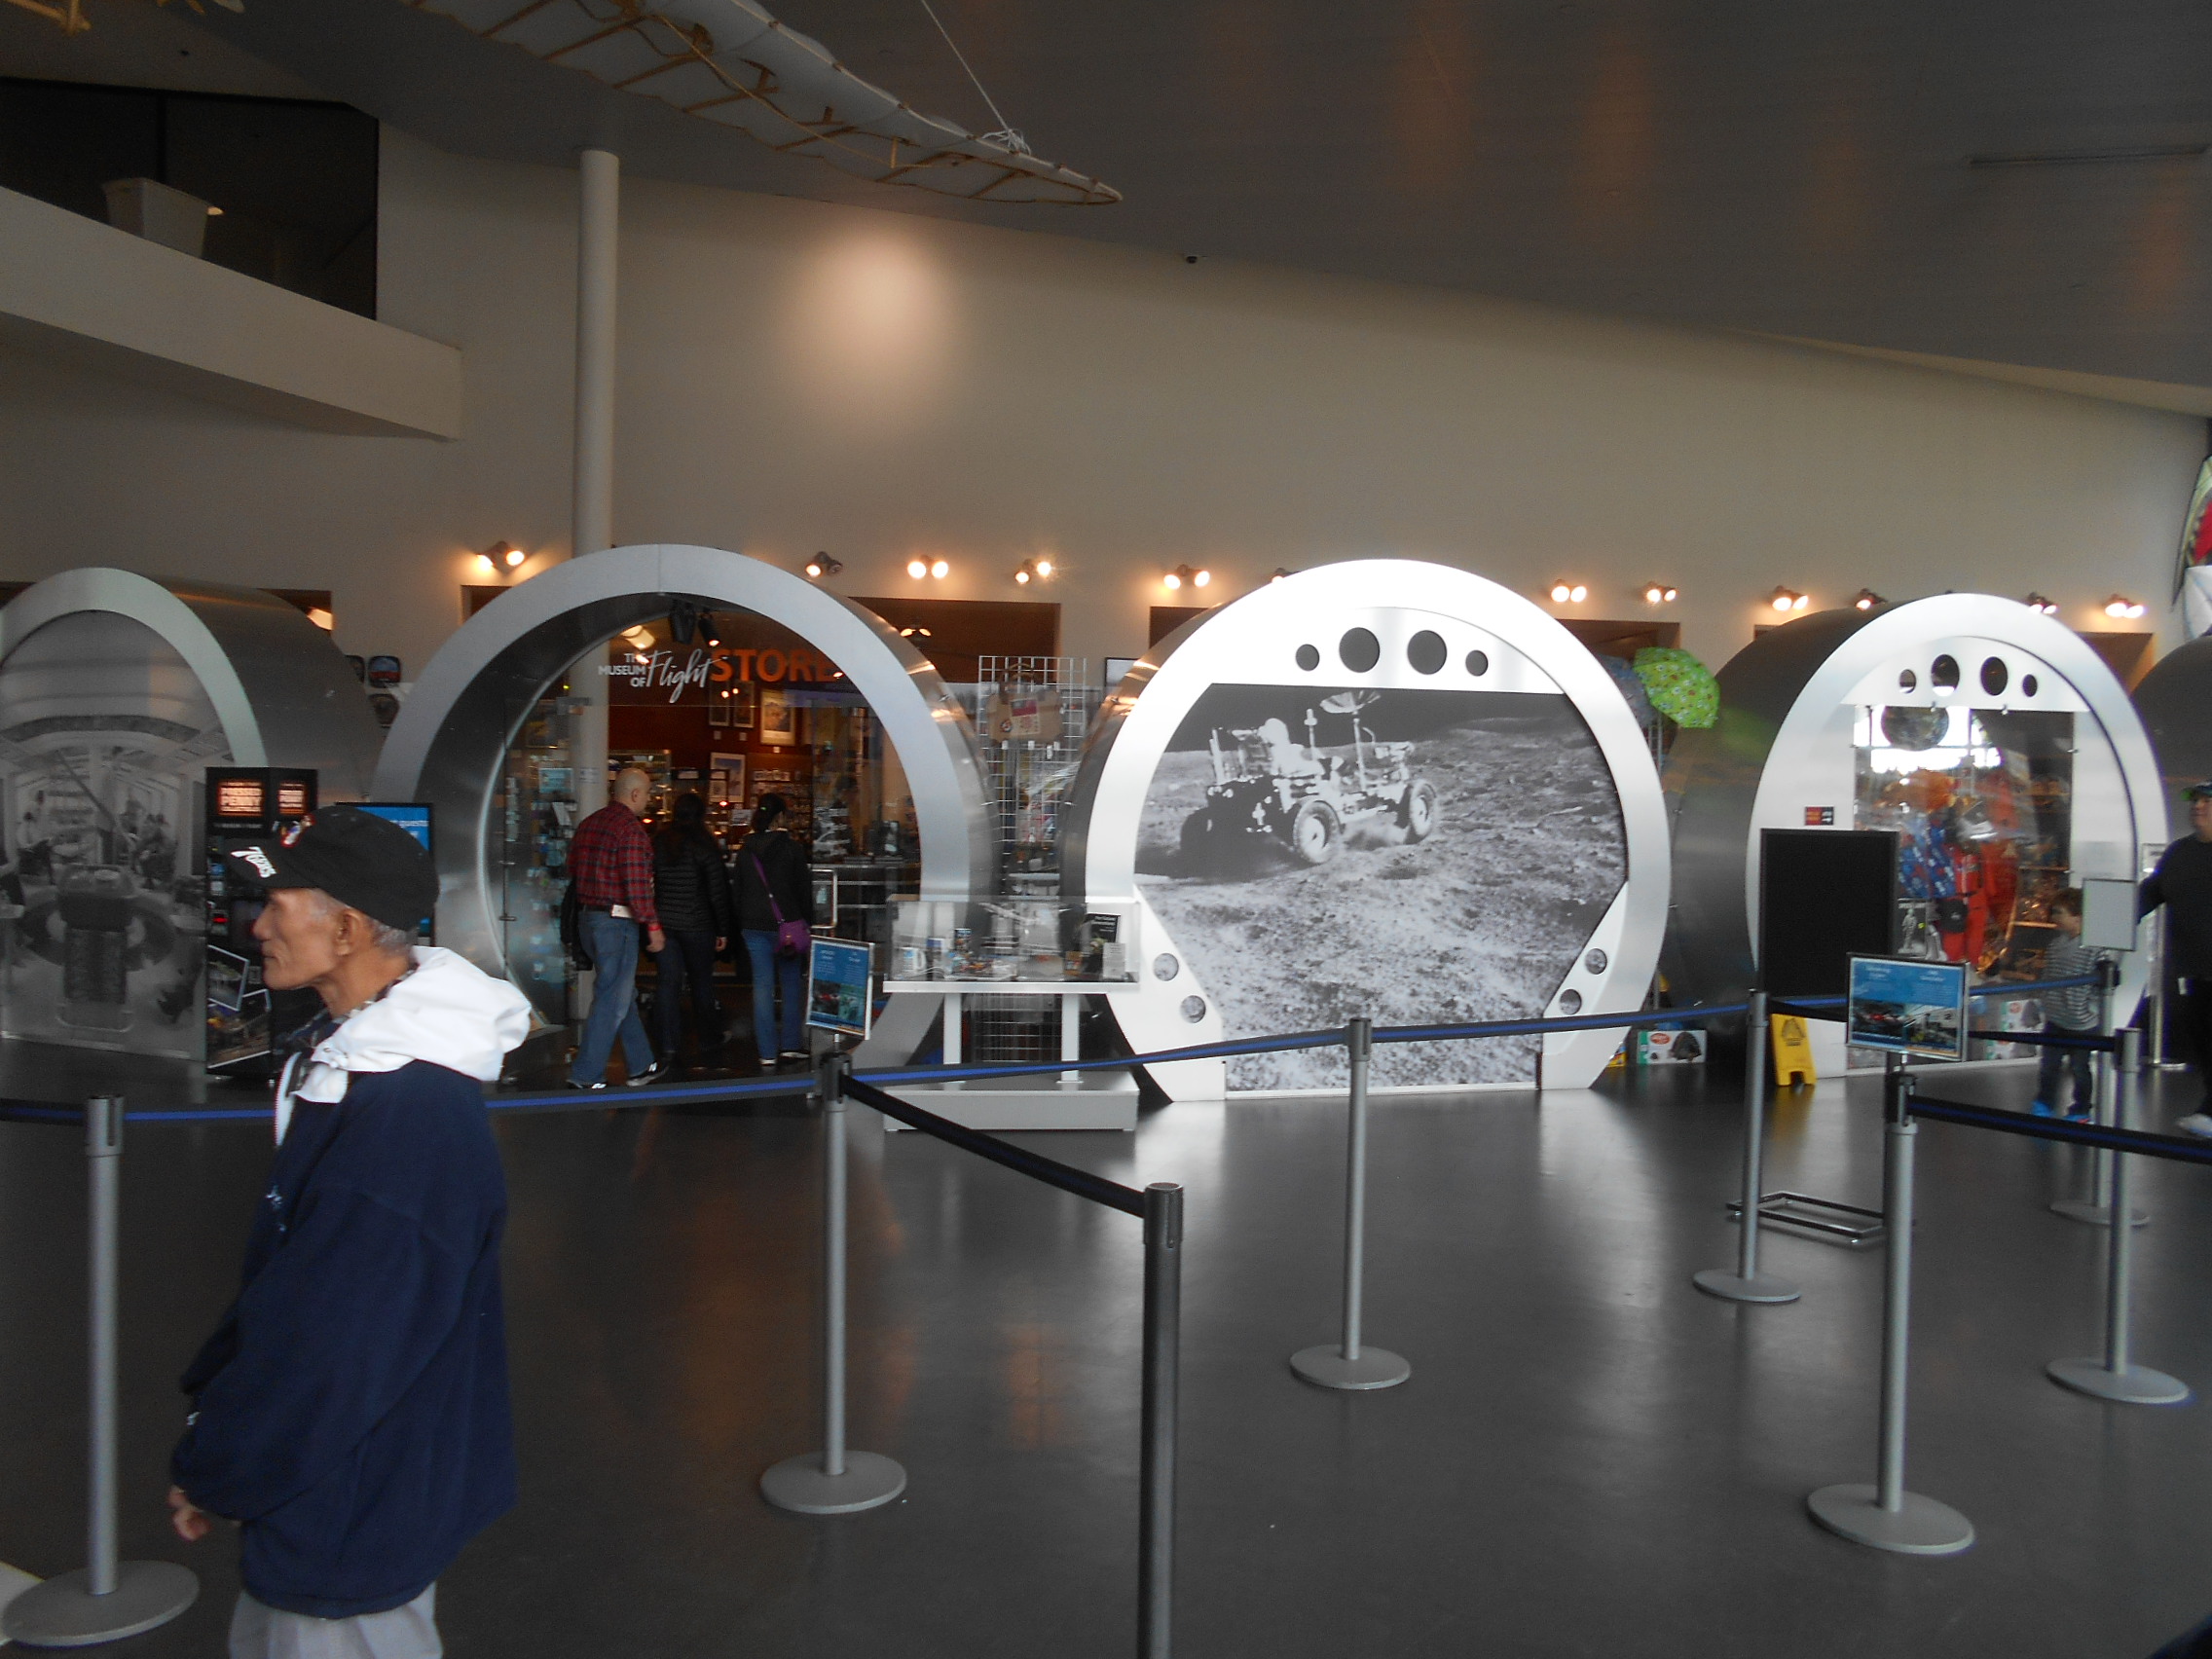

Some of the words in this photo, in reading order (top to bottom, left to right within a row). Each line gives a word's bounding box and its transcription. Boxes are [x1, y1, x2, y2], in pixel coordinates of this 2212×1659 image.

[624, 651, 647, 663] TH
[598, 665, 646, 676] MUSEUM
[645, 648, 726, 704] Flight
[710, 648, 837, 682] STORE
[630, 677, 646, 687] OF
